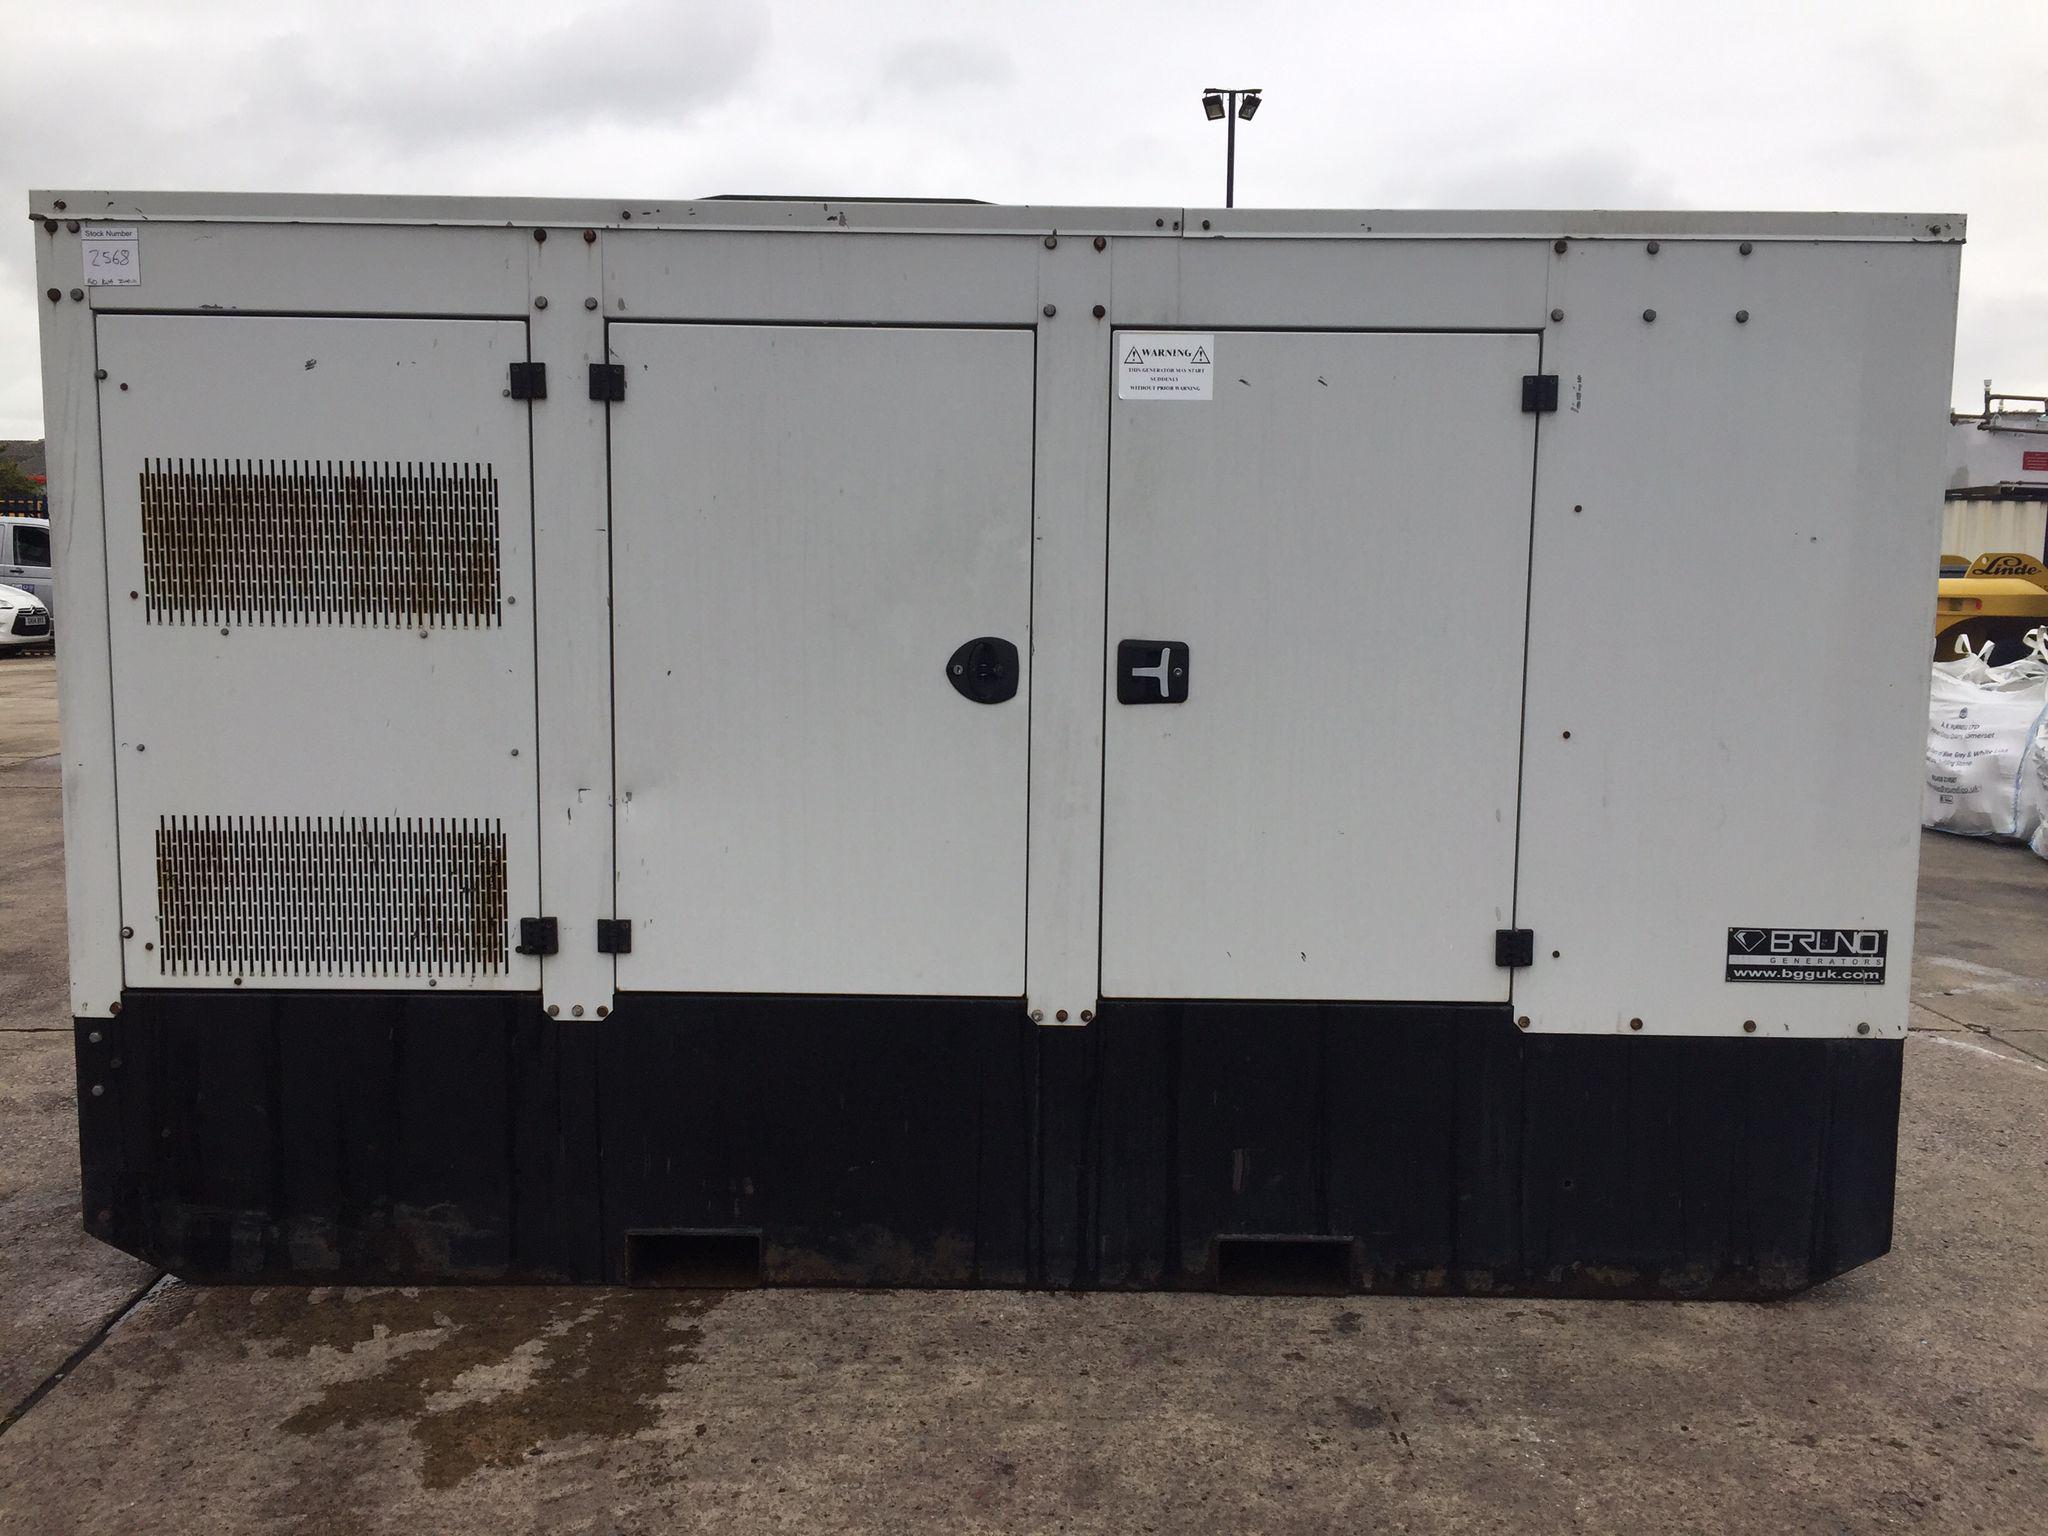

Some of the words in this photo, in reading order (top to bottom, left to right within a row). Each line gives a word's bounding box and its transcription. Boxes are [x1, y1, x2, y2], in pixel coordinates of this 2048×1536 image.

[89, 249, 130, 267] 2568
[1141, 348, 1192, 357] WARNING
[1972, 555, 2042, 576] Linde
[1770, 930, 1880, 954] BRUNO
[1769, 957, 1882, 966] GENERATORS
[1733, 968, 1880, 981] www.bgguk.com
